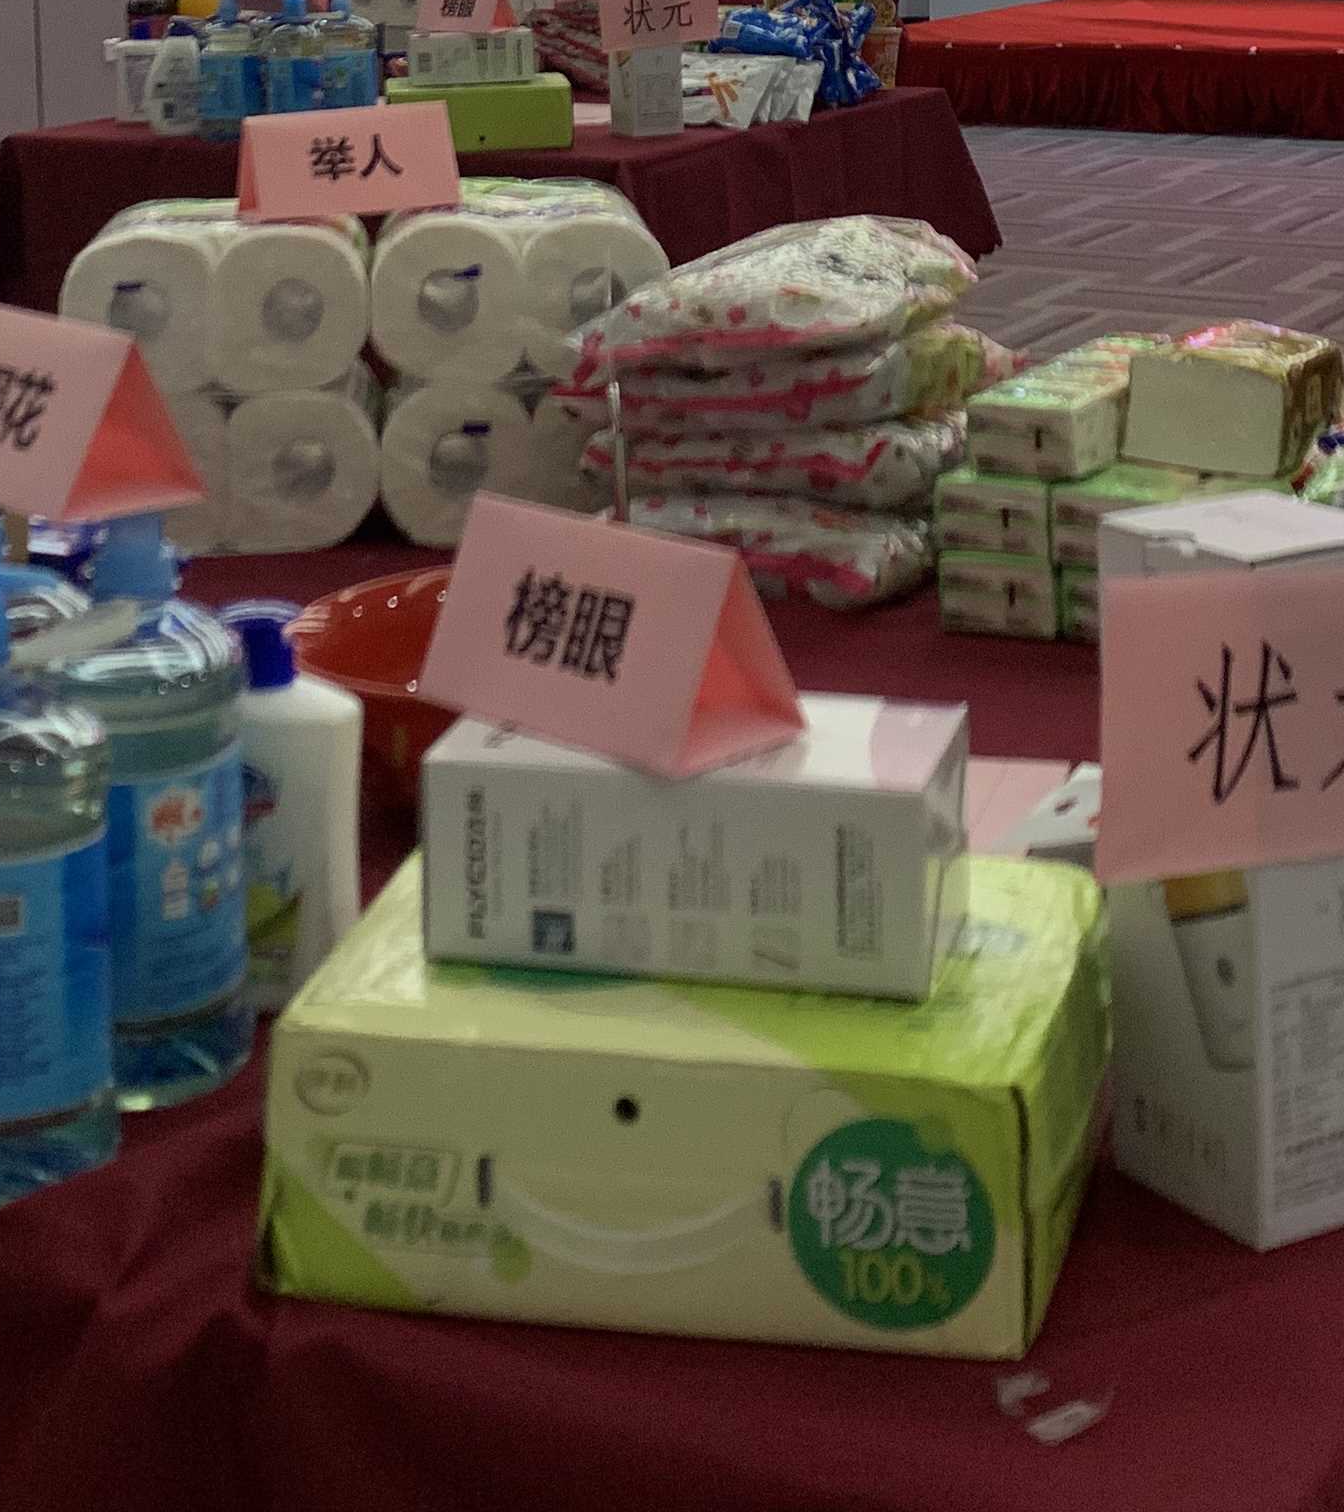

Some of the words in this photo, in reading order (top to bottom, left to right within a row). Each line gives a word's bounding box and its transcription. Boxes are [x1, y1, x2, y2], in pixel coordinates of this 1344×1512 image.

[308, 133, 403, 180] 举人
[505, 567, 635, 684] 榜眼
[806, 1156, 971, 1256] 畅意
